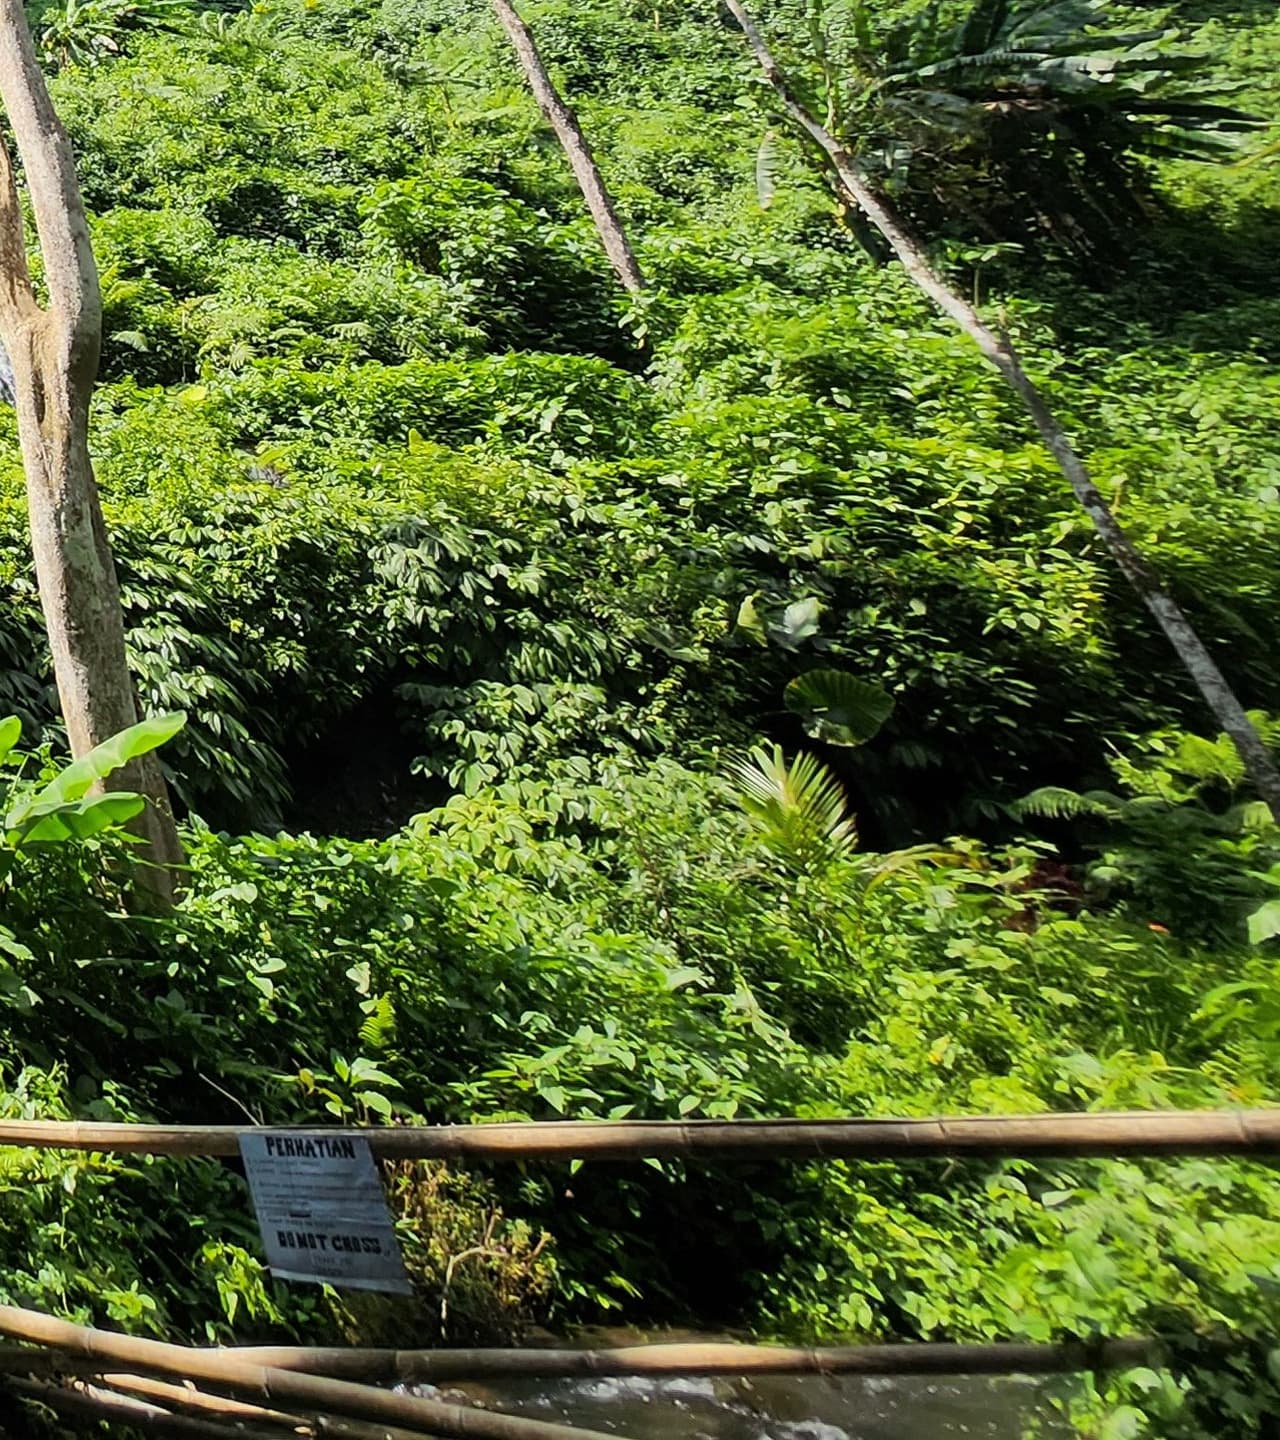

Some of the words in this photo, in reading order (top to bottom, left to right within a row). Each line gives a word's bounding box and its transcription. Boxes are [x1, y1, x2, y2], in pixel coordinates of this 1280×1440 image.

[266, 1137, 355, 1158] PERHATIAN
[277, 1231, 294, 1248] DO
[295, 1232, 326, 1251] NOT
[332, 1235, 381, 1255] CROSS
